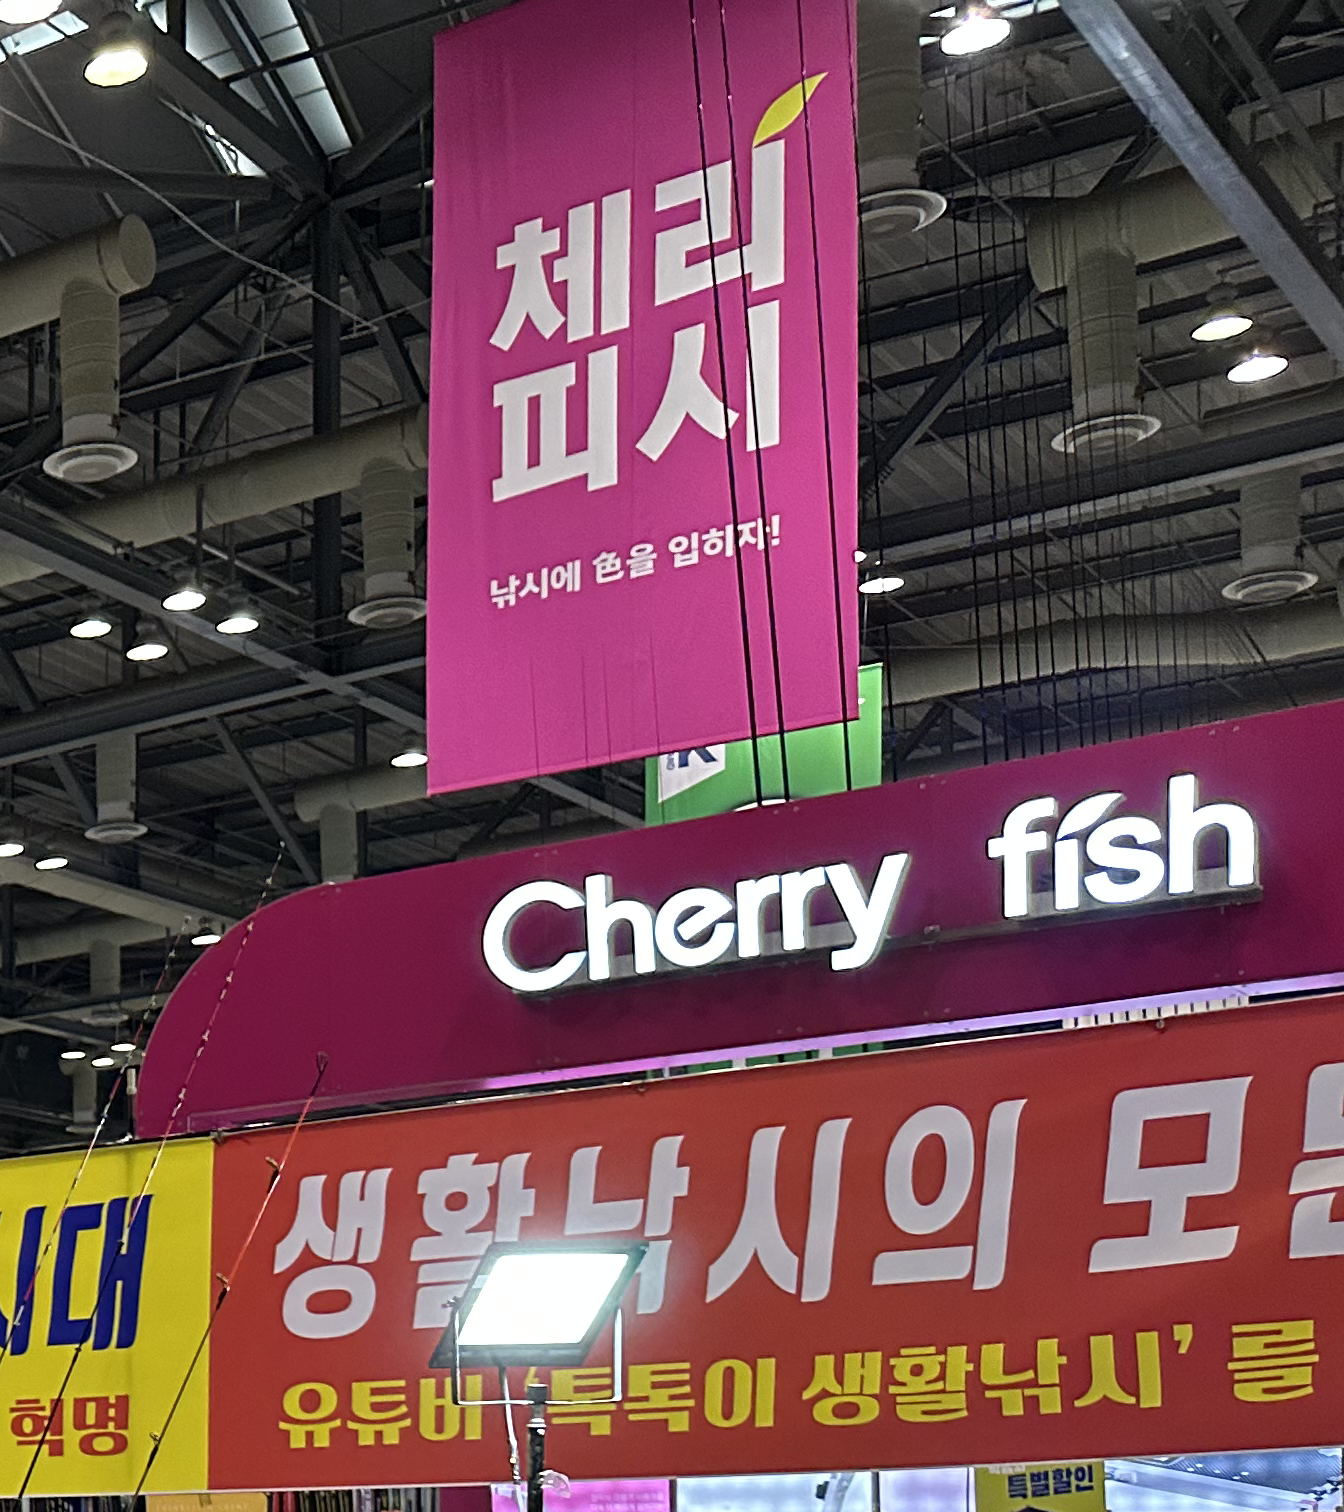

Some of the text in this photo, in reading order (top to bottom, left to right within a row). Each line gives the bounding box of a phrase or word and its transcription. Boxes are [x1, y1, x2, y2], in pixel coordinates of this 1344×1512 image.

[491, 138, 787, 353] 체리
[491, 299, 782, 503] 피시
[488, 513, 782, 610] 낚시에 色을 입히자!
[481, 773, 1259, 995] Cherry fish
[272, 1097, 1029, 1340] 생활낚시의
[8, 1392, 131, 1462] 혁명
[1227, 1318, 1321, 1403] 를
